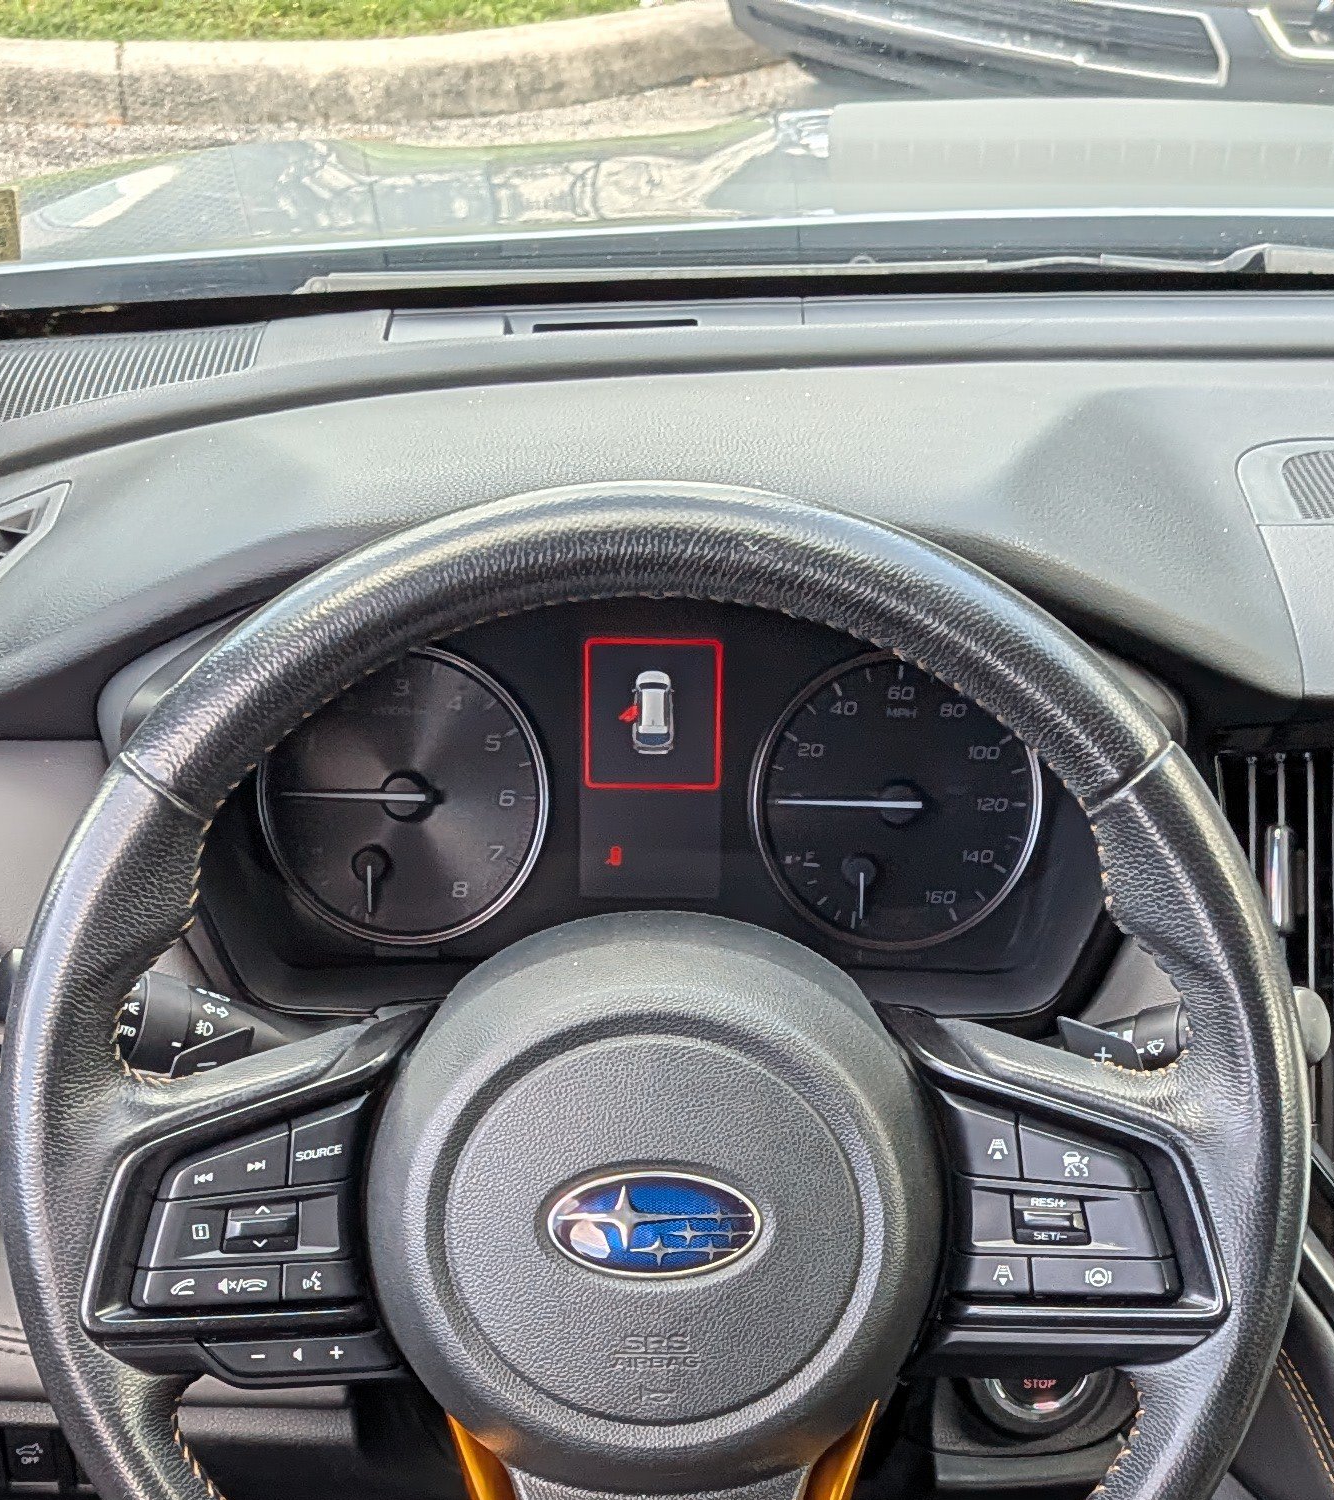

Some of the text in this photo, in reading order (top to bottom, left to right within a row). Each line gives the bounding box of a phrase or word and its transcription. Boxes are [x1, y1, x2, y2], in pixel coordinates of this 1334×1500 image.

[887, 686, 915, 700] 60
[830, 701, 858, 716] 40
[886, 707, 917, 719] MPH
[939, 703, 967, 718] 80
[485, 734, 501, 752] 5
[797, 743, 824, 758] 20
[968, 745, 1000, 760] 100
[498, 789, 515, 807] 6
[976, 798, 1008, 812] 120
[489, 845, 505, 861] 7
[962, 850, 994, 864] 140
[452, 881, 468, 898] 8
[924, 890, 957, 905] 160
[295, 1144, 343, 1162] SOURCE
[1023, 1379, 1057, 1389] STOP
